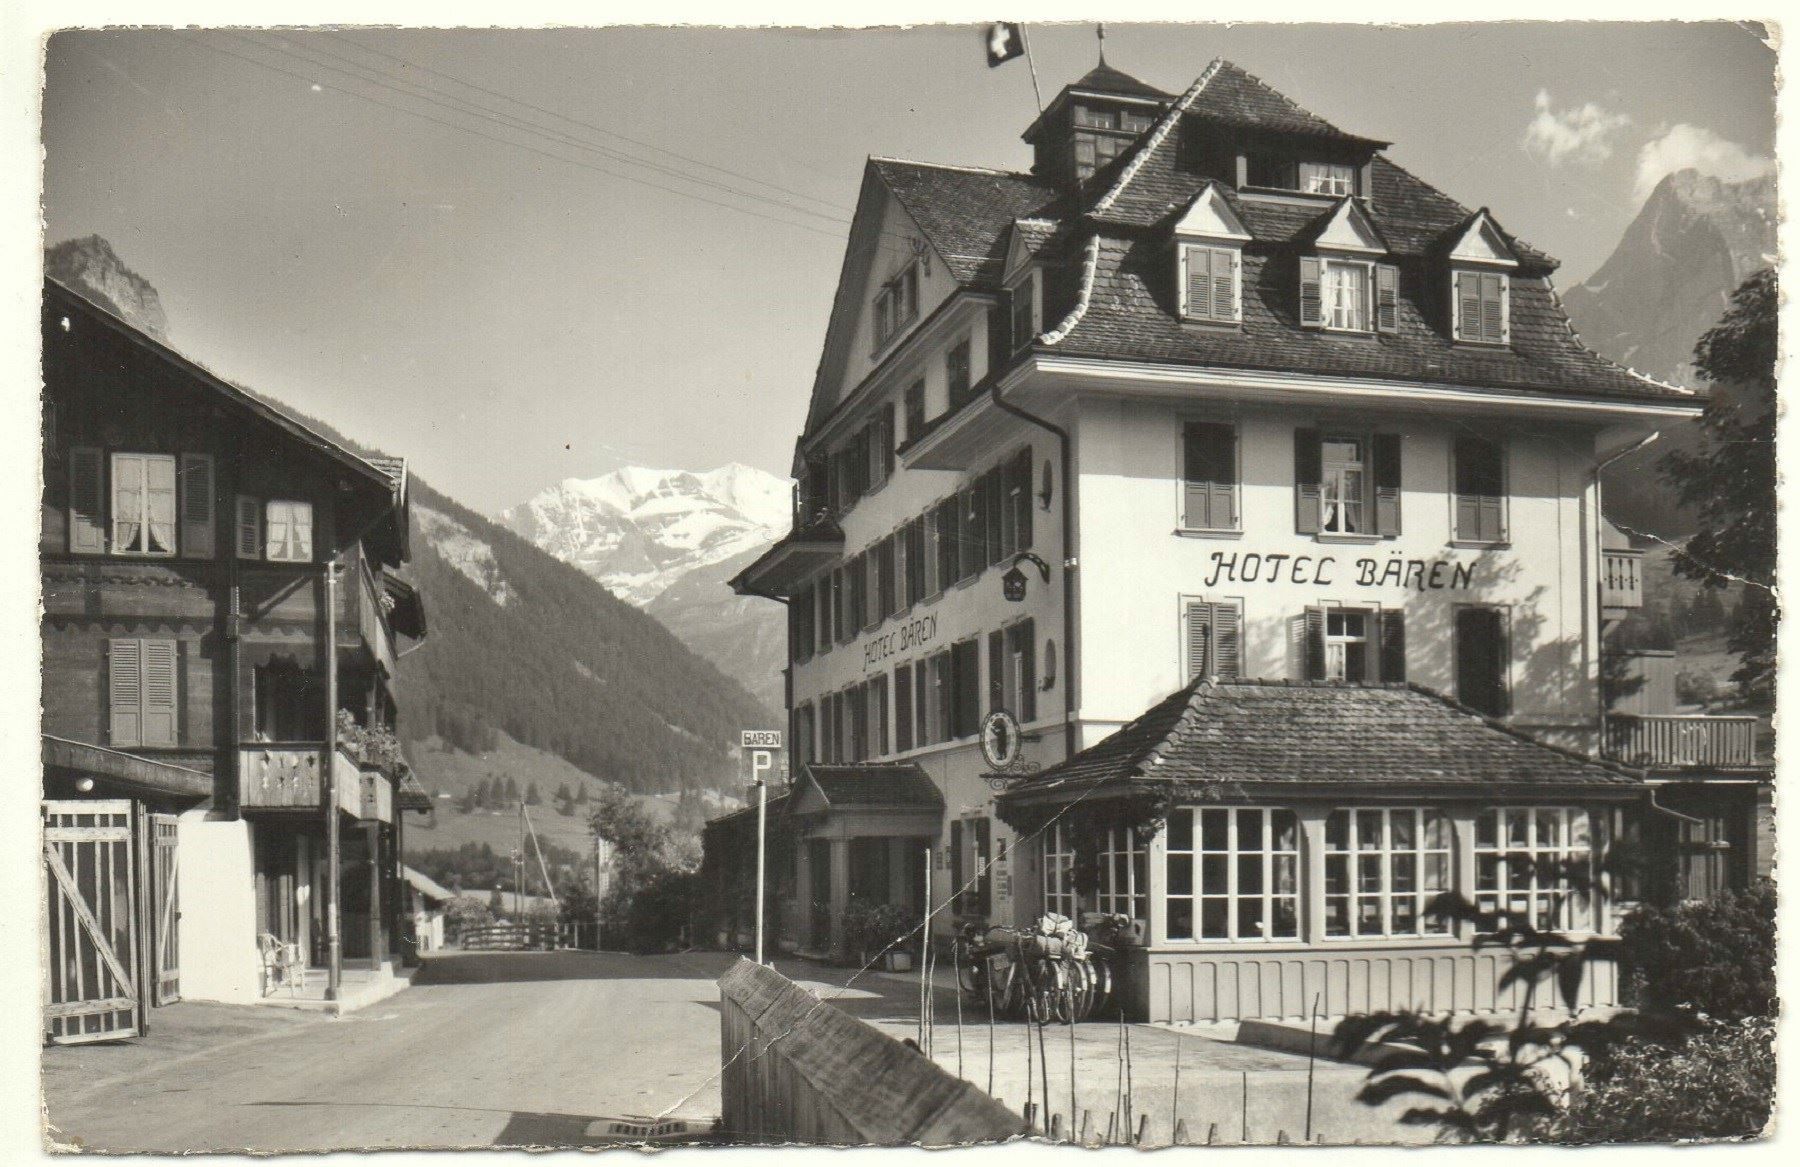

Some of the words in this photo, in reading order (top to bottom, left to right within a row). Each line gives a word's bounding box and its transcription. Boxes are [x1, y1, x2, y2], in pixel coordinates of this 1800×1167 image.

[1204, 552, 1336, 587] HOTEL
[1356, 550, 1477, 592] BÄREN
[862, 632, 896, 672] HOTEL
[752, 750, 772, 781] P
